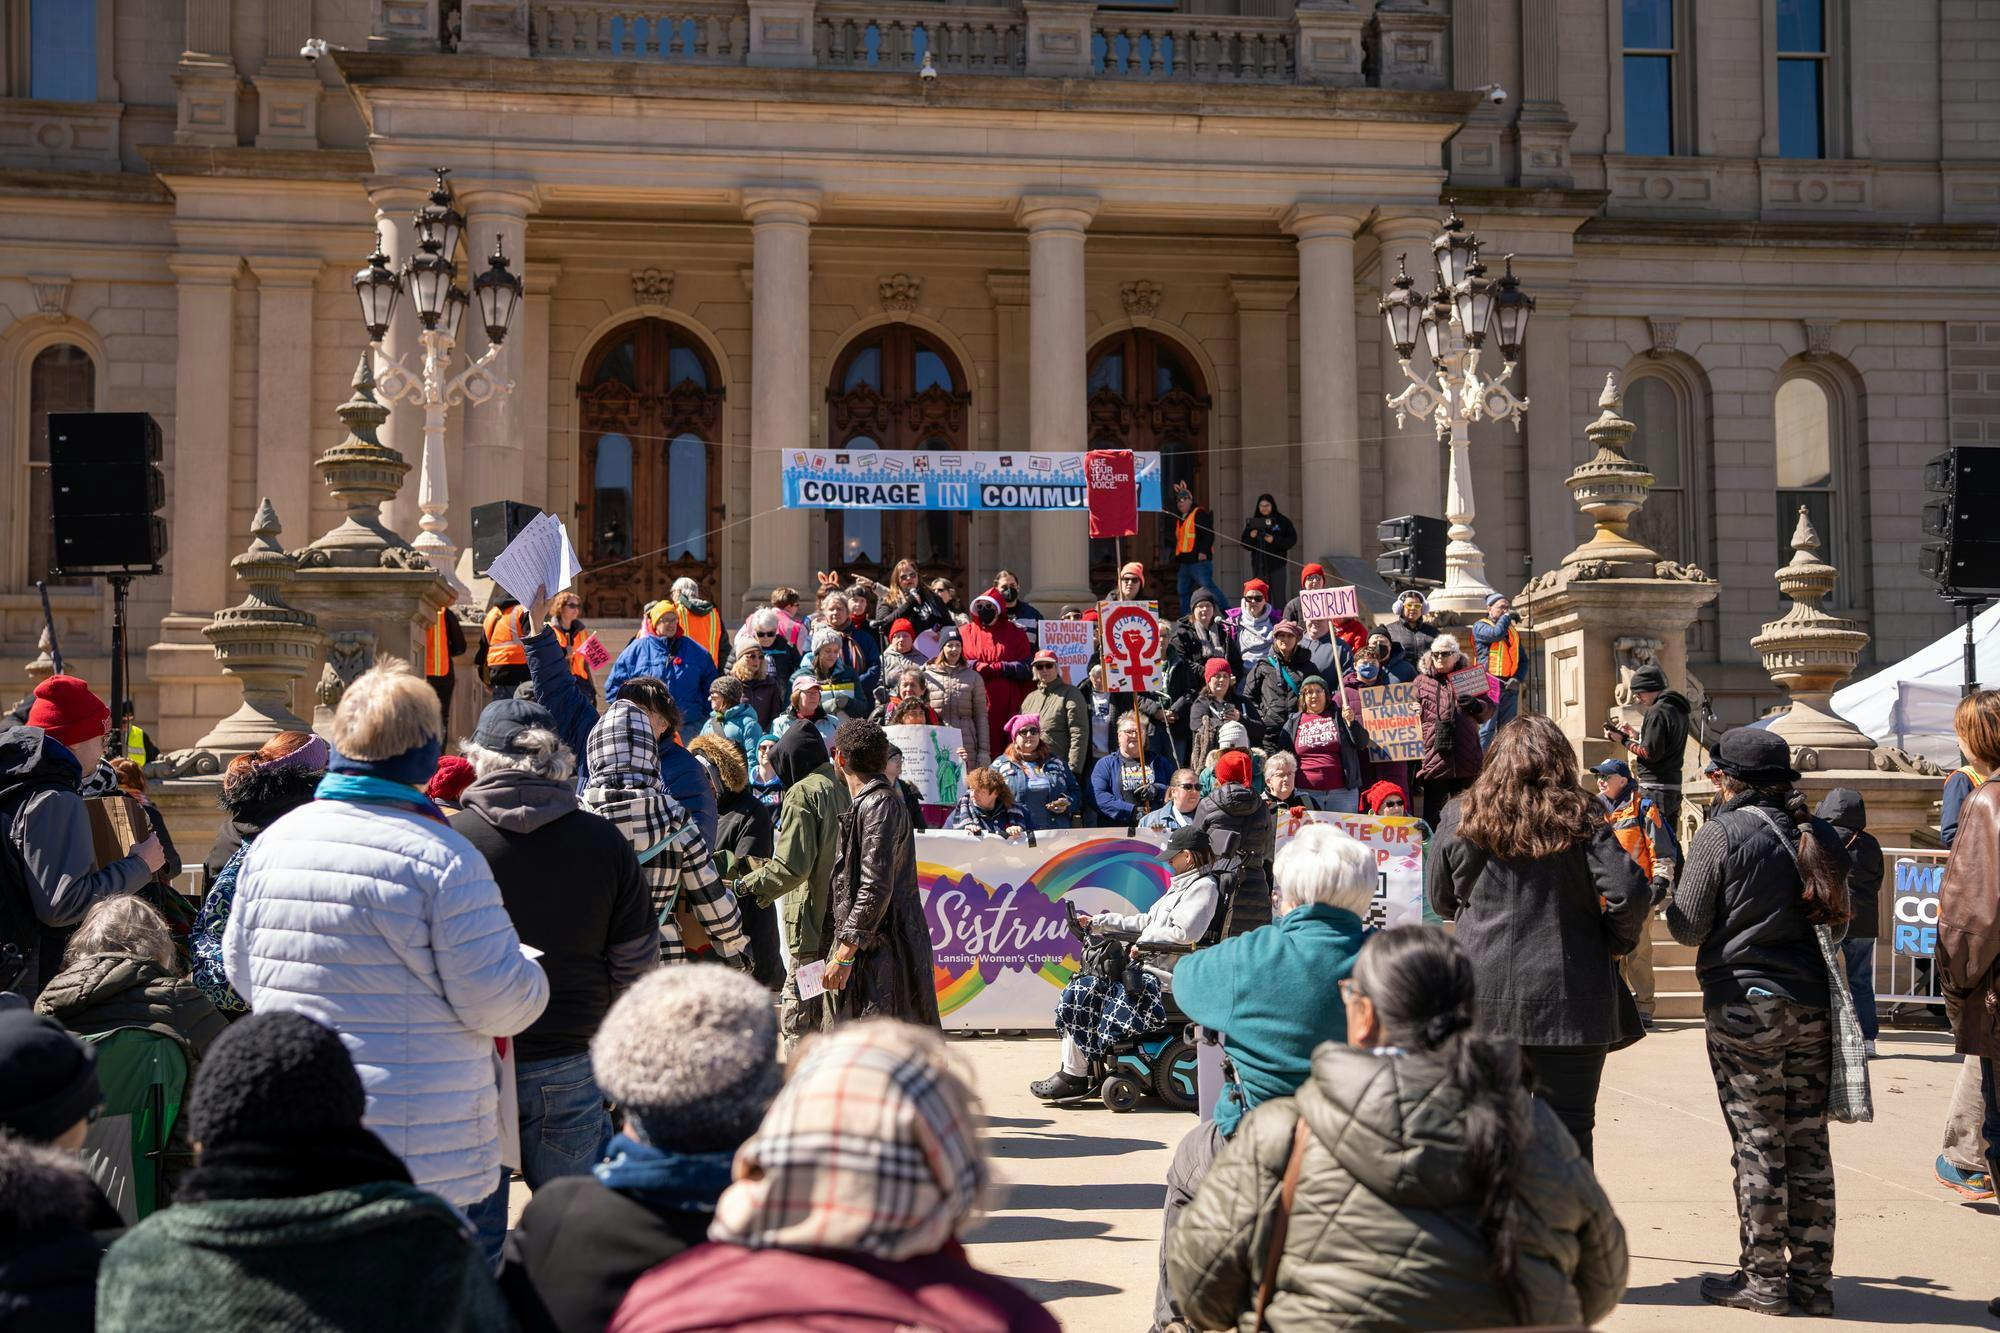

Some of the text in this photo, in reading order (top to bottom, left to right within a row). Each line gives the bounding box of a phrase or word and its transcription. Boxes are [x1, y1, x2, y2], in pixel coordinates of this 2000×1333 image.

[1090, 458, 1106, 466] USE
[1090, 466, 1113, 474] YOUR
[1091, 473, 1129, 482] TEACHER
[1091, 481, 1117, 489] VOICE.
[803, 481, 920, 504] COURAGE
[941, 484, 965, 506] IN
[1301, 590, 1356, 619] SISTRUM
[1045, 622, 1088, 633] SO MUCH
[1113, 615, 1155, 650] SOLIDARITY
[1045, 633, 1088, 645] WRONG
[1362, 685, 1414, 708] BLACK
[1364, 715, 1420, 732] IMMIGRANT
[1298, 731, 1338, 747] HISTORY
[1372, 726, 1418, 743] LIVES
[1370, 741, 1425, 762] MATTER
[1382, 825, 1409, 843] OR
[938, 954, 1063, 964] Lansing Women's Chorus
